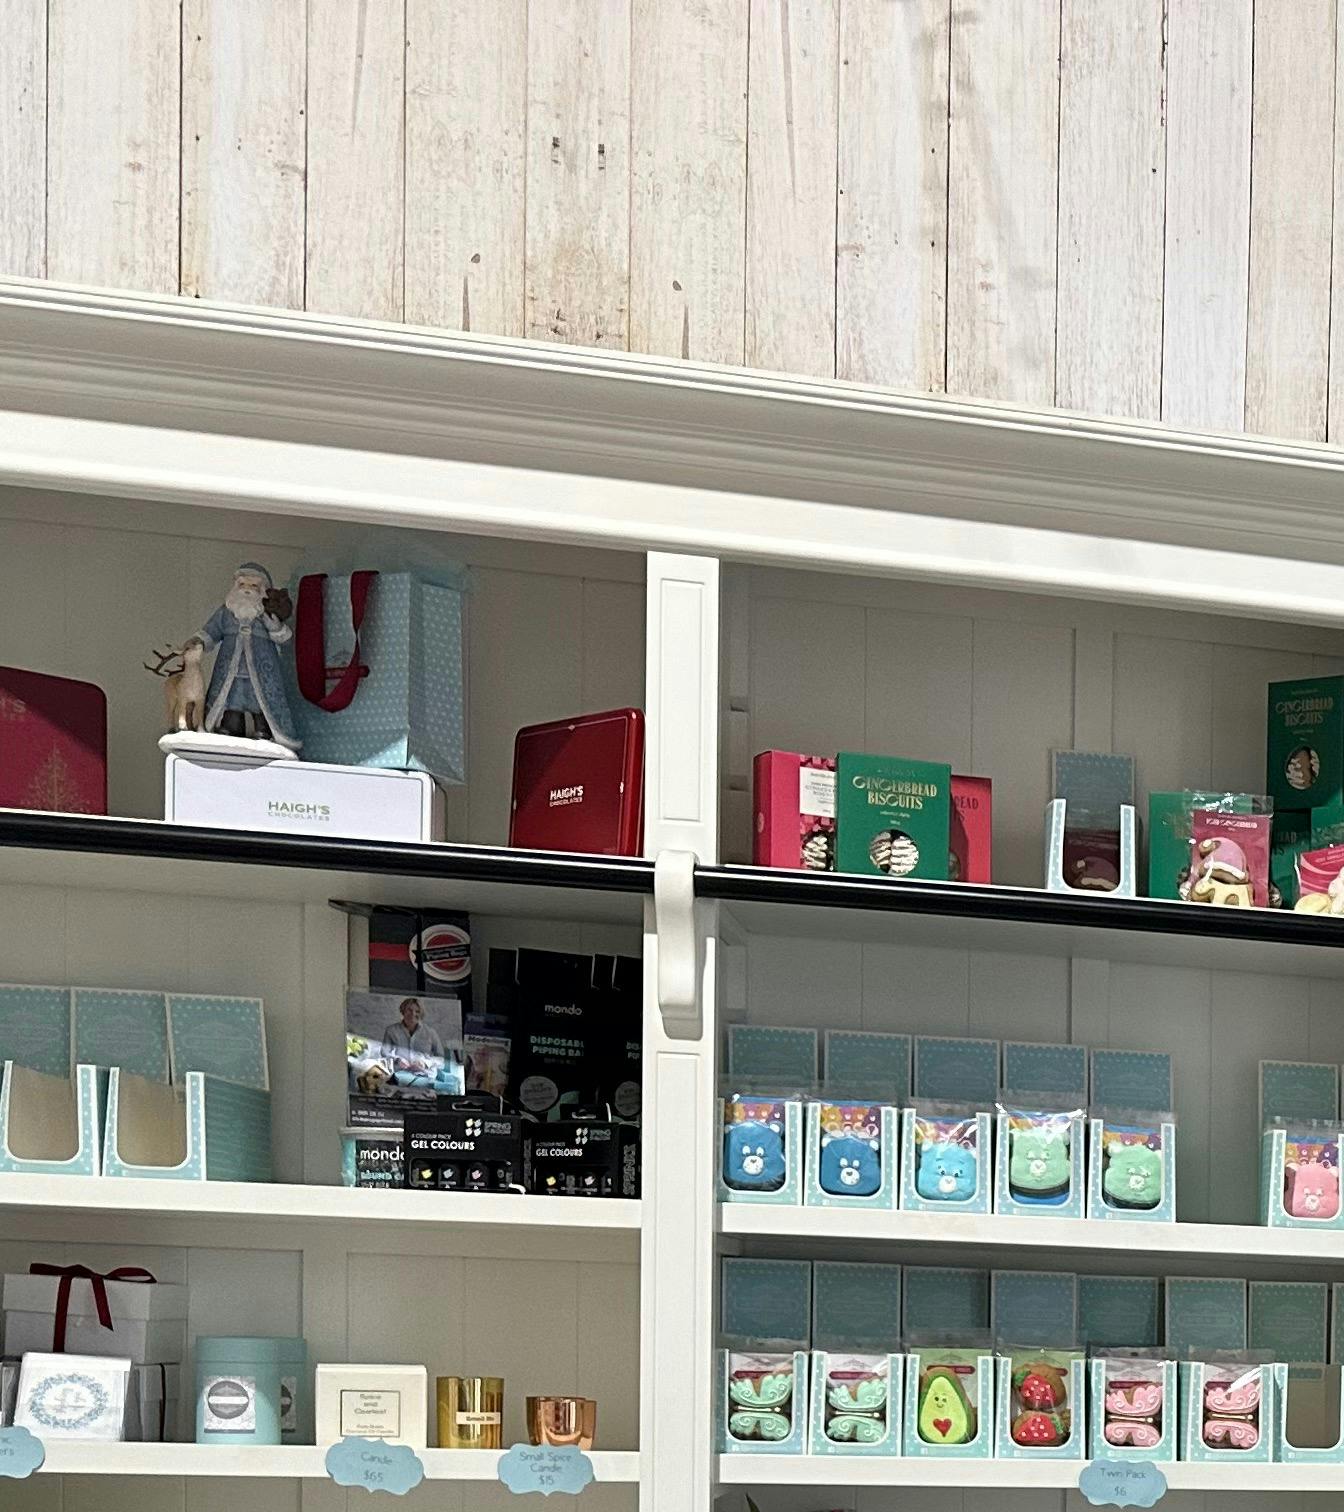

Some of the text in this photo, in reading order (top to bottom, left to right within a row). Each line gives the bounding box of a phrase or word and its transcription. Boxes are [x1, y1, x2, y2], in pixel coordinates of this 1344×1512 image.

[550, 785, 584, 800] HAIGH'S
[852, 775, 938, 798] GINGERBREAD
[867, 791, 923, 810] BISCUITS
[268, 801, 330, 815] HAIGH'S
[544, 1003, 583, 1016] mondo
[410, 1140, 475, 1151] GEL COLOURS
[535, 1148, 583, 1157] GEL COLOURS
[360, 1451, 393, 1465] Candle
[519, 1451, 572, 1463] Small Spice
[529, 1462, 563, 1474] Candle
[1099, 1467, 1147, 1479] Twin Pack
[363, 1469, 384, 1482] $65
[538, 1474, 555, 1486] $15
[1114, 1486, 1127, 1497] $6
